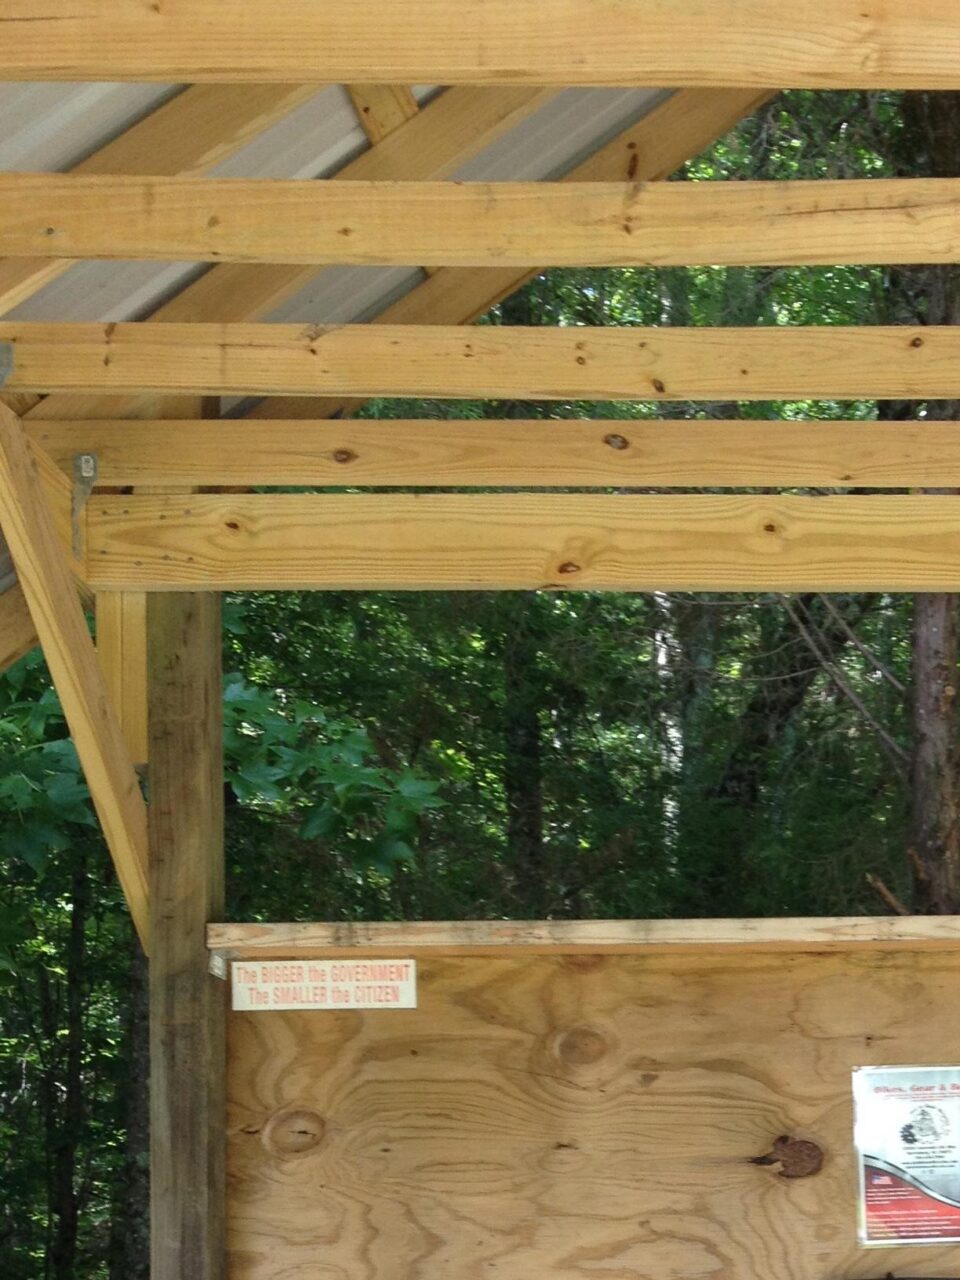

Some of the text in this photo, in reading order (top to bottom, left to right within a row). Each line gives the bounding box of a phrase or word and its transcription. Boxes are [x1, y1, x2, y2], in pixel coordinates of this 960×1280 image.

[261, 965, 304, 983] BIGGER
[331, 964, 411, 982] GOVERNMENT
[273, 986, 327, 1004] SMALLER
[354, 985, 400, 1003] CITIZEN
